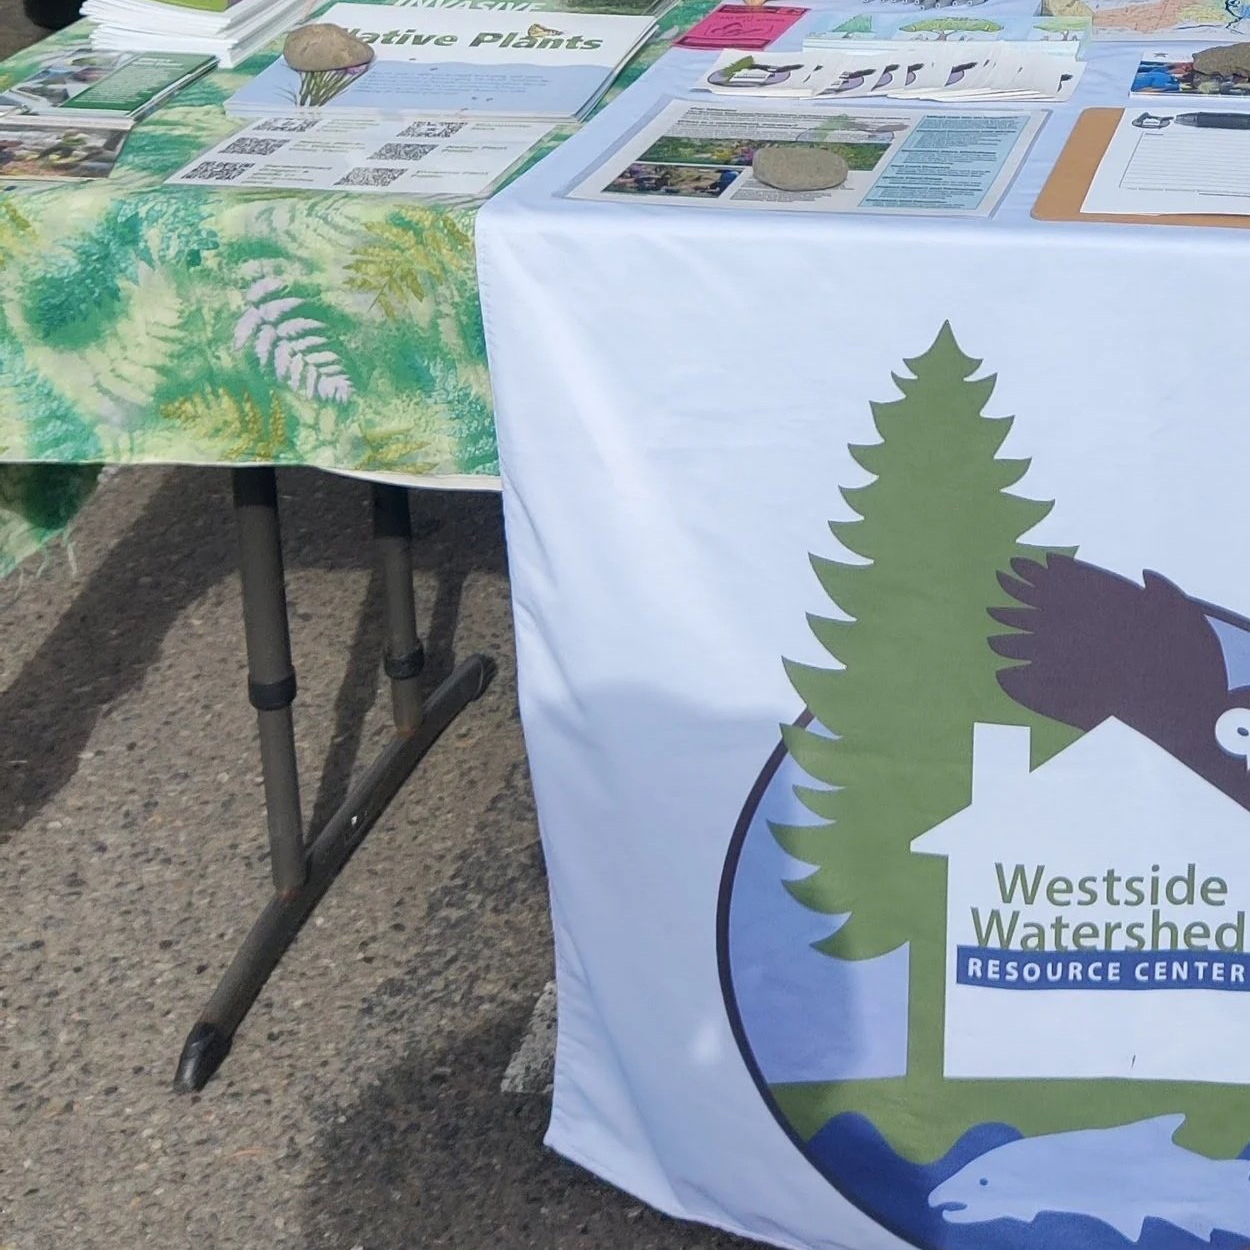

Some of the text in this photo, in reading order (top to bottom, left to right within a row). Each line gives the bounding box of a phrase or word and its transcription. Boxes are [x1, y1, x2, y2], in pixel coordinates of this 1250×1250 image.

[469, 31, 603, 51] Plants
[994, 862, 1228, 907] Westside
[970, 906, 1245, 953] Watershed
[967, 957, 1245, 984] RESOURCE CENTER
